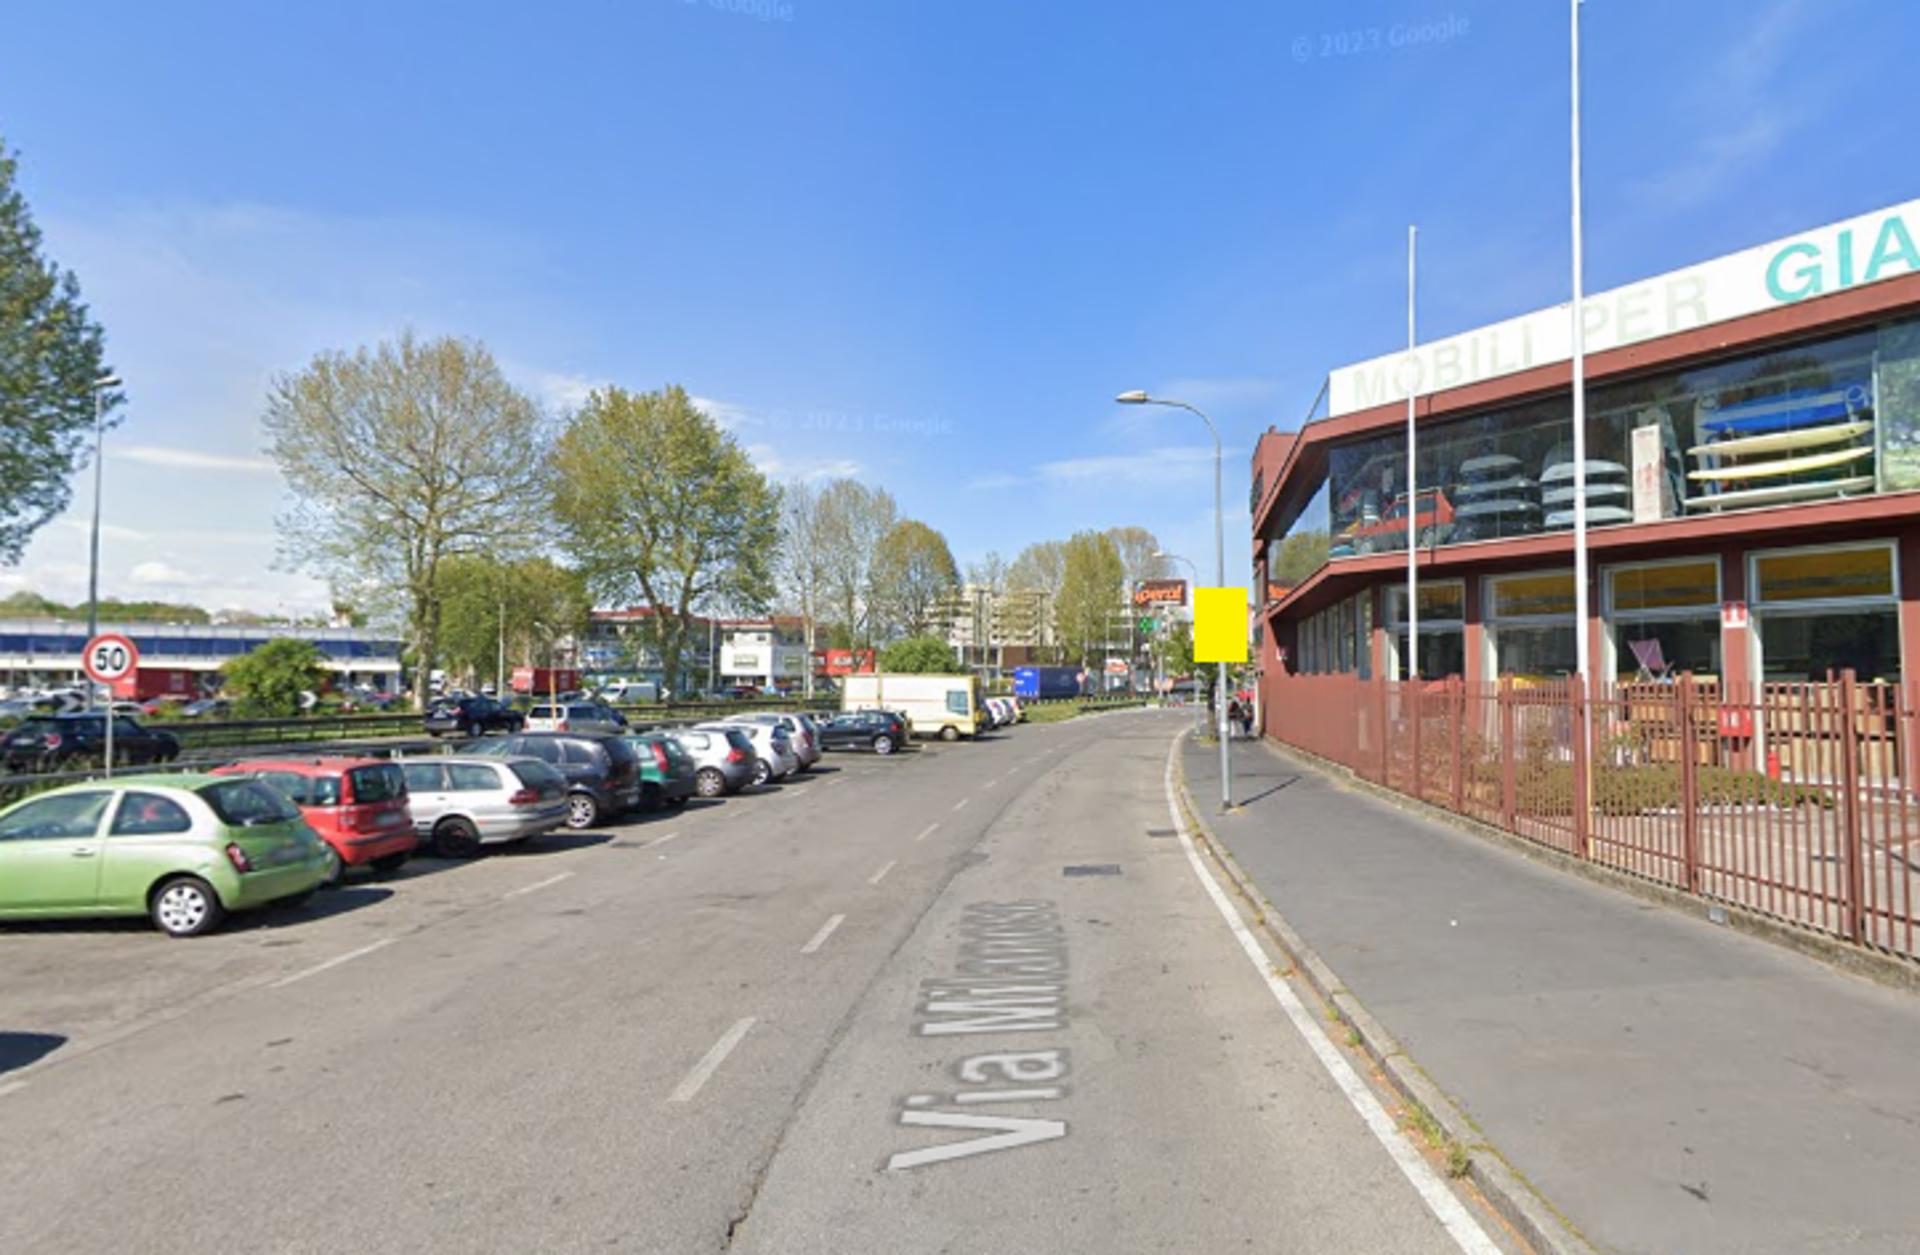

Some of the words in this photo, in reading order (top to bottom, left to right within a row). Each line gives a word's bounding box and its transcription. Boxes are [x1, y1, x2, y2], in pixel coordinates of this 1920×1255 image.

[1353, 322, 1535, 404] MOBILI
[1579, 275, 1709, 353] PER
[1765, 215, 1920, 304] GIA
[96, 647, 126, 671] 50
